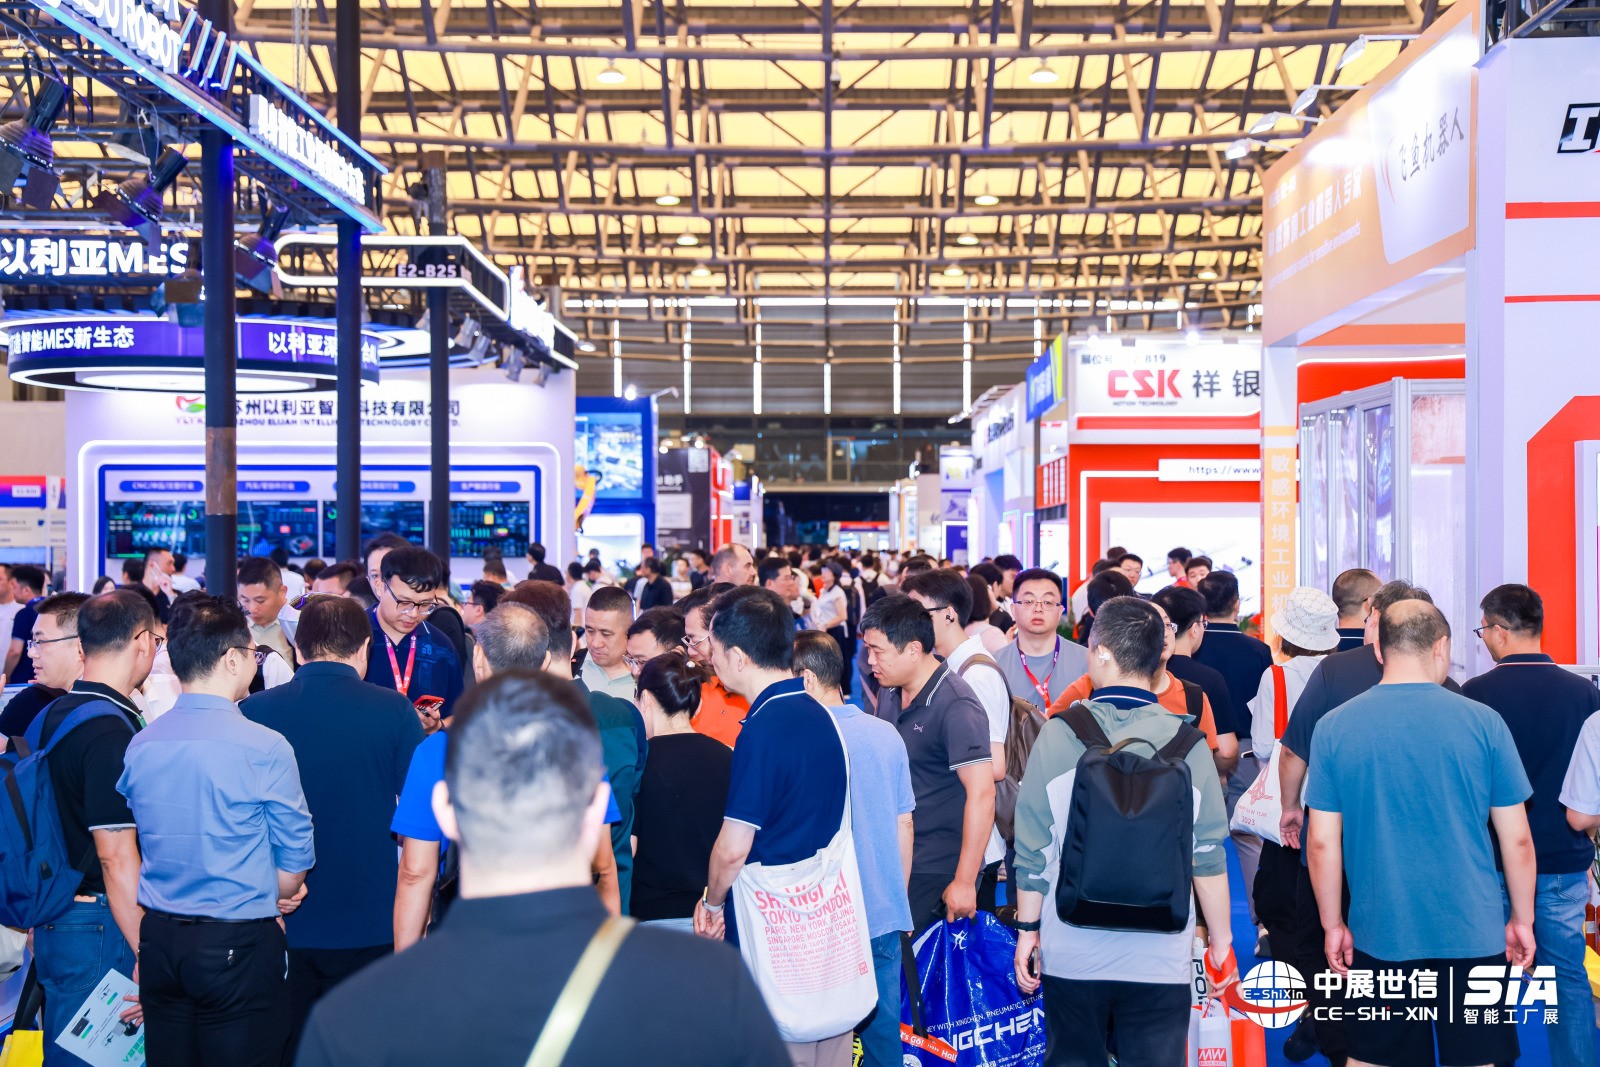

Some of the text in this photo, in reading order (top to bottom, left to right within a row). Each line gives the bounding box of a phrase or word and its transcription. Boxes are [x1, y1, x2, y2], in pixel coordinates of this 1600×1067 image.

[1399, 106, 1464, 181] 飞鱼机器人
[397, 264, 457, 278] E2-B25
[1107, 369, 1182, 398] CSK
[764, 926, 787, 935] PARIS
[790, 924, 807, 934] NEW
[808, 919, 828, 931] YORK
[767, 934, 805, 945] SINGAPORE
[835, 916, 858, 931] OSAKA
[986, 1001, 1022, 1018] PNEUMATIC
[910, 1036, 925, 1046] Go!
[1199, 1048, 1226, 1061] MW
